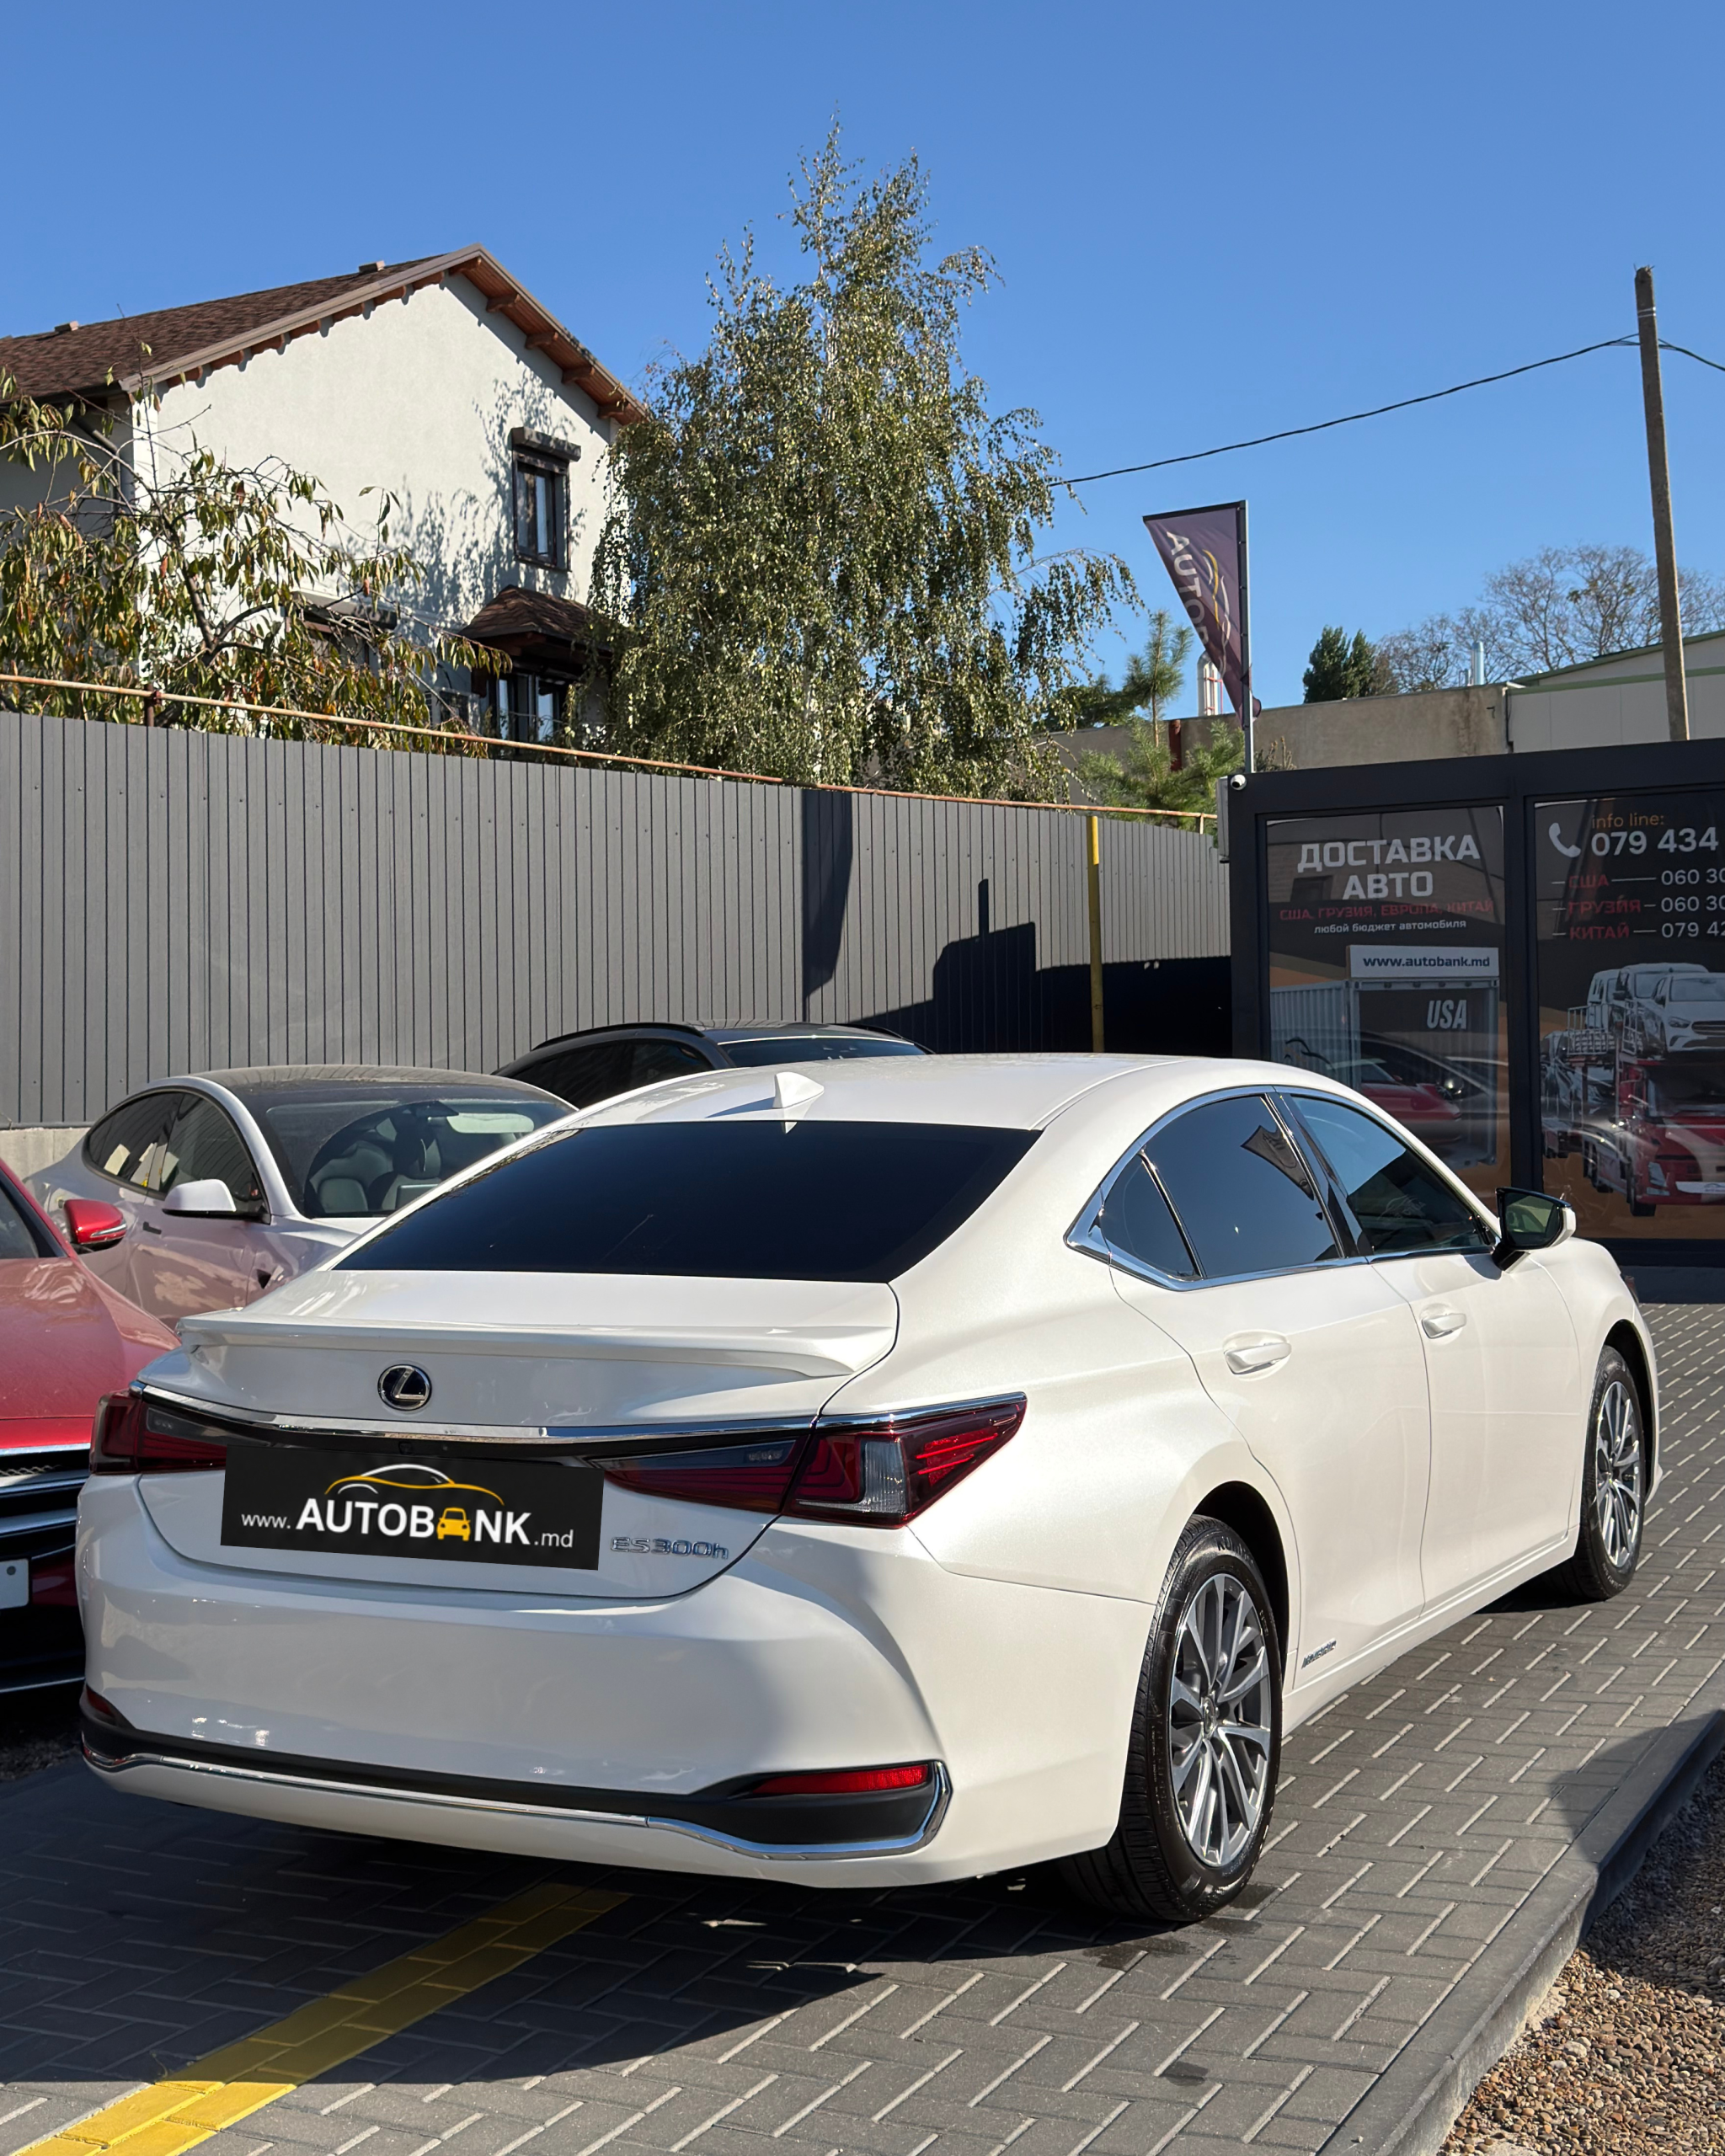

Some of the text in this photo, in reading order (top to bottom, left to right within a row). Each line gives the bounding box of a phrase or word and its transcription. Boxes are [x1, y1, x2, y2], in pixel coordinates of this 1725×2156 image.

[1591, 813, 1664, 829] info line:
[1591, 826, 1719, 857] 079 434
[1297, 835, 1482, 873] ДОСТАВКА
[1342, 871, 1434, 900] АВТО
[1568, 873, 1610, 889] США
[1661, 868, 1700, 885] 060
[1661, 896, 1700, 912] 060
[1314, 919, 1467, 934] любой бюджет автомобиля
[1568, 922, 1629, 940] КИТАЙ
[1662, 921, 1700, 938] 079
[1363, 957, 1490, 968] www.autobank.md
[1426, 1000, 1467, 1030] USA
[610, 1535, 729, 1560] ES300h
